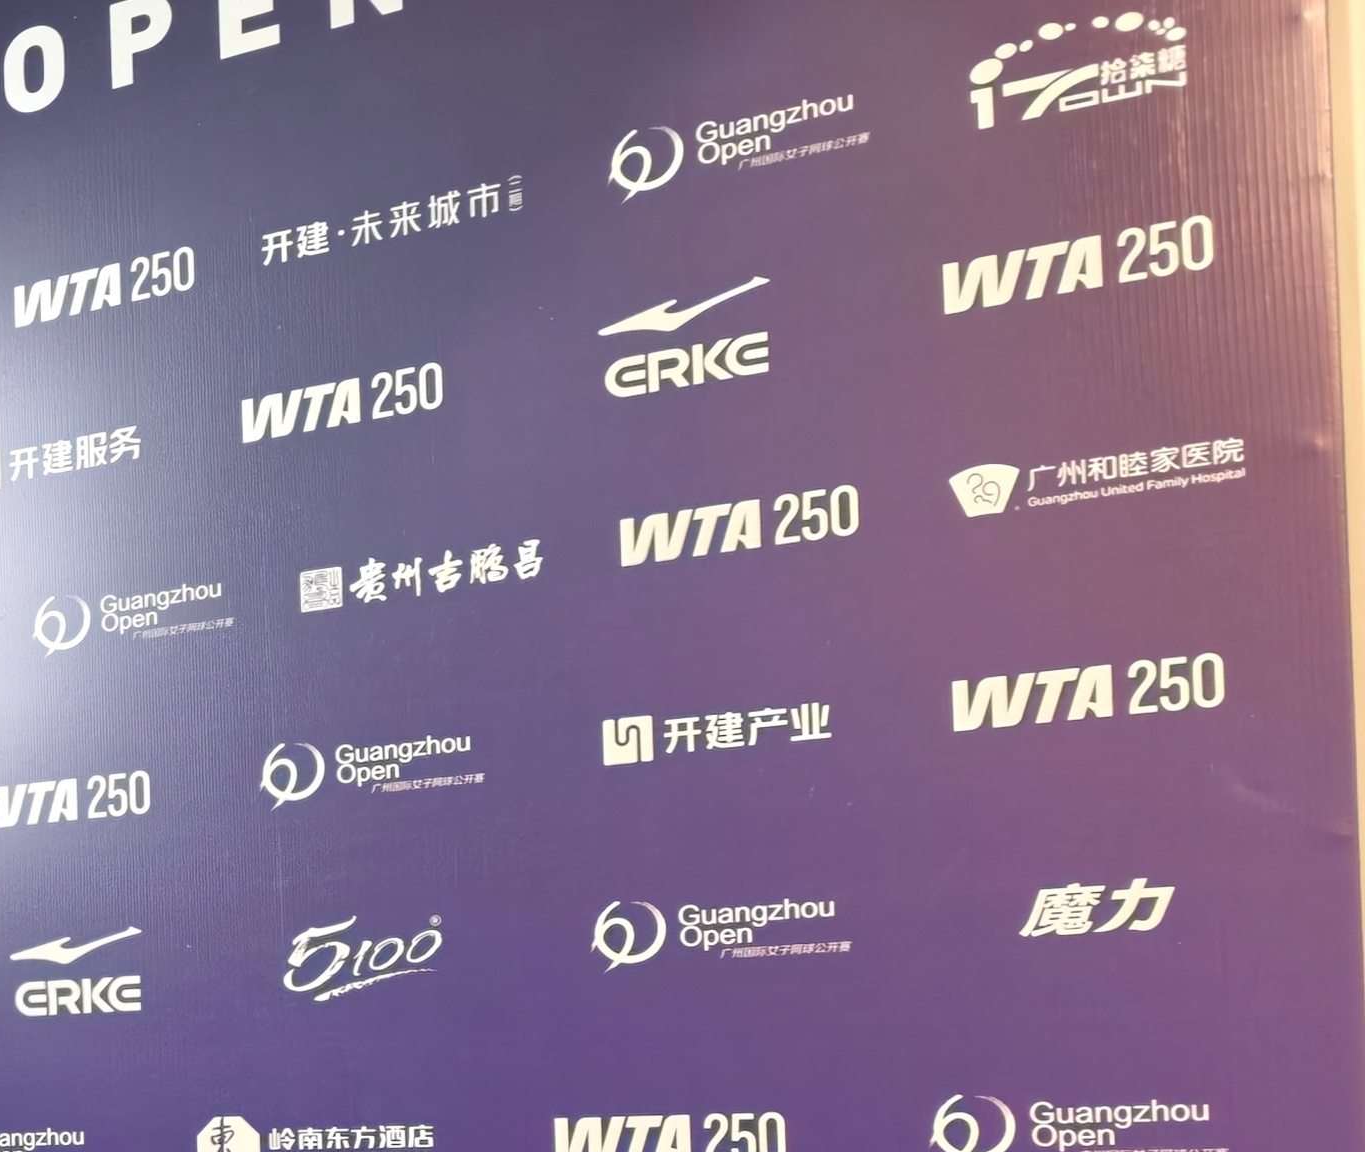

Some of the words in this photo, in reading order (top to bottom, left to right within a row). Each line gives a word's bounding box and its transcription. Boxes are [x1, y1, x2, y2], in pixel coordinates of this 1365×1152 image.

[696, 91, 854, 146] Guangzhou
[697, 131, 772, 168] Open
[13, 262, 122, 329] WTA
[130, 246, 195, 302] 250
[942, 234, 1104, 315] WTA
[1116, 214, 1215, 284] 250
[604, 331, 770, 398] ERKE
[241, 377, 361, 444] WTA
[370, 362, 444, 420] 250
[9, 425, 142, 483] 开建服务
[1026, 436, 1246, 490] 广州和睦家医院
[1027, 490, 1099, 507] Guangzhou
[1100, 481, 1145, 497] United
[1146, 476, 1190, 491] Family
[1190, 467, 1246, 484] Hospital
[619, 498, 762, 568] WTA
[773, 484, 859, 546] 250
[100, 583, 222, 620] Guangzhou
[101, 608, 158, 637] Open
[951, 664, 1114, 732] WTA
[1127, 652, 1225, 715] 250
[335, 734, 471, 768] Guangzhou
[663, 702, 832, 754] 开建产业
[86, 770, 151, 819] 250
[336, 758, 400, 789] Open
[678, 898, 835, 929] Guangzhou
[1018, 877, 1176, 938] 魔力
[282, 915, 443, 1002] 5100
[679, 922, 752, 953] Open
[14, 975, 142, 1017] ERKE
[268, 1124, 434, 1151] 岭南东方酒店
[1030, 1100, 1209, 1128] Guangzhou
